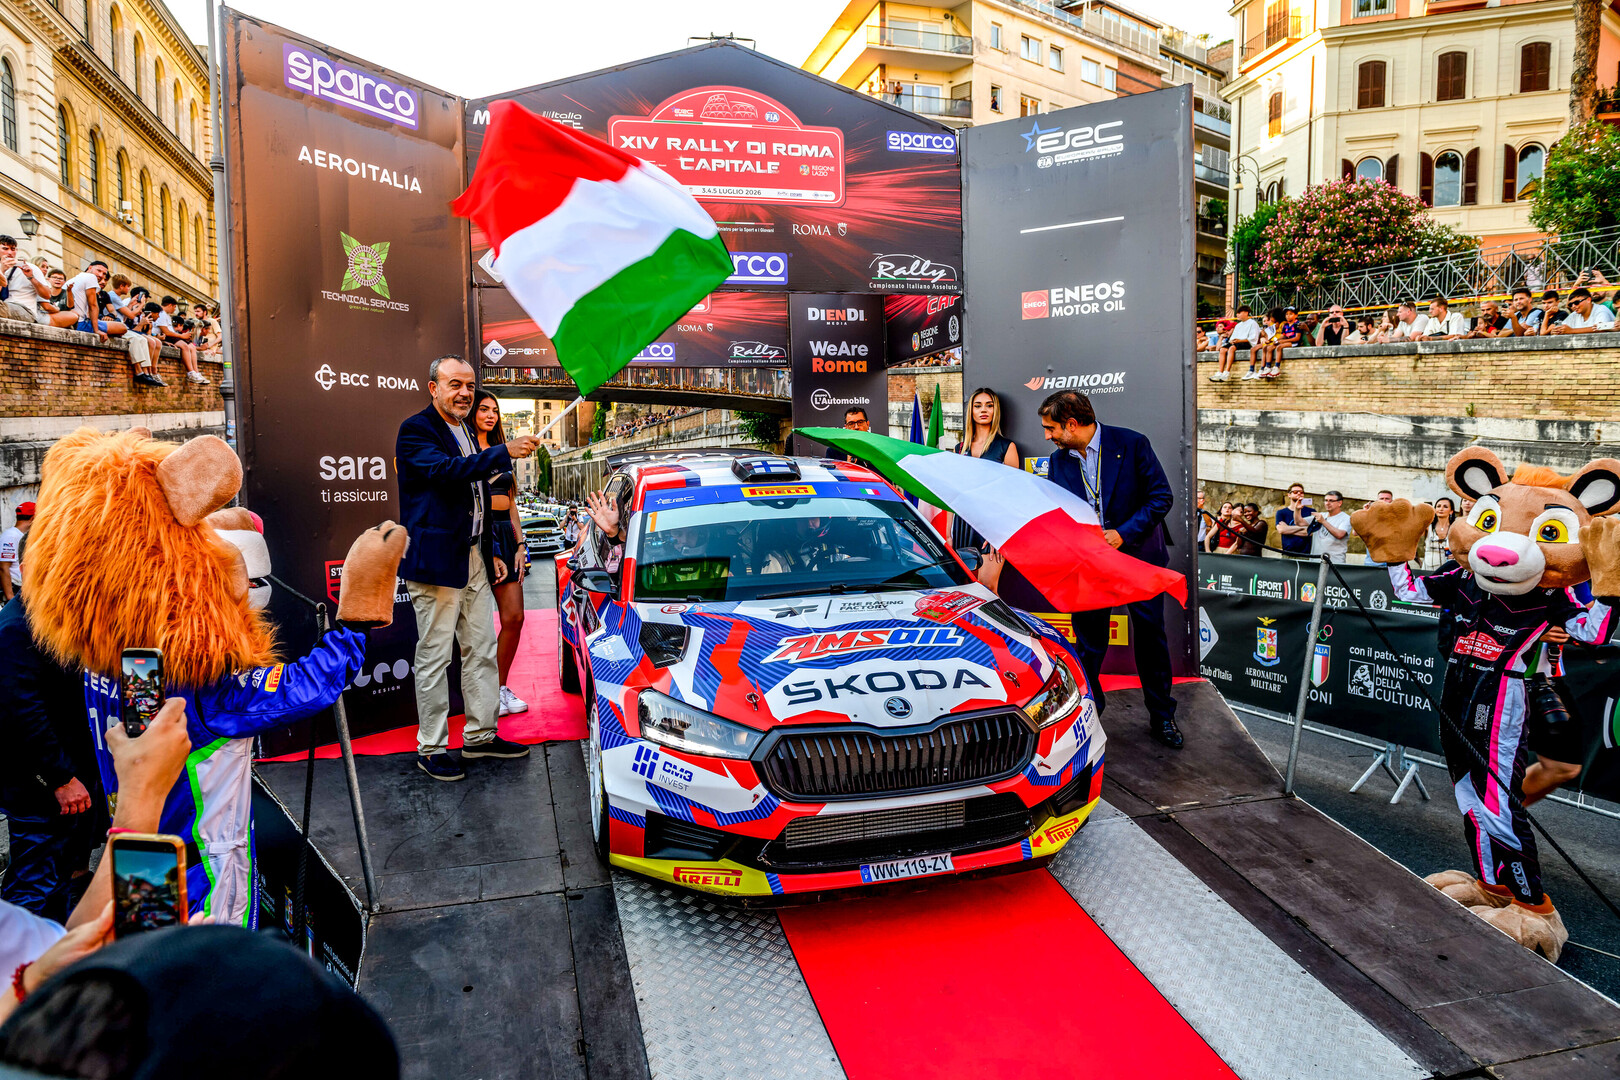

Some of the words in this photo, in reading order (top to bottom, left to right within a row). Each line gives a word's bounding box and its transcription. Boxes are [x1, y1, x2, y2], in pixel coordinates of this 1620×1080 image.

[288, 51, 415, 116] sparco
[888, 132, 954, 151] sparco
[1036, 120, 1124, 154] ERC
[620, 135, 659, 150] XIV
[666, 137, 740, 152] RALLY
[747, 141, 766, 154] DI
[772, 143, 834, 158] ROMA
[680, 158, 780, 174] CAPITALE
[1056, 152, 1122, 166] CHAMPIONSHIP
[298, 145, 422, 194] AEROITALIA
[792, 224, 831, 236] ROMA
[730, 255, 784, 276] rco
[876, 260, 946, 284] Rally
[1050, 280, 1126, 304] ENEOS
[321, 290, 370, 306] TECHNICAL
[370, 298, 410, 312] SERVICES
[1024, 301, 1046, 309] ENEOS
[1052, 303, 1100, 318] MOTOR
[1104, 300, 1126, 312] OIL
[920, 326, 938, 339] REGIONE
[809, 340, 868, 356] WeAre
[921, 337, 934, 348] LAZIO
[733, 345, 780, 359] Rally
[812, 358, 867, 372] Roma
[340, 372, 369, 387] BCC
[378, 376, 419, 391] ROMA
[1091, 386, 1124, 394] emotion
[319, 455, 386, 480] sara
[321, 490, 331, 502] ti
[334, 488, 388, 502] assicura
[749, 487, 808, 495] PIRELLI
[649, 512, 658, 532] 1
[1221, 574, 1232, 583] MIT
[1257, 580, 1283, 591] SPORT
[1262, 590, 1283, 599] SALUTE
[1326, 598, 1348, 607] AZIO
[761, 627, 965, 664] AMSOIL
[1350, 646, 1365, 656] con
[1367, 647, 1372, 657] il
[1424, 657, 1434, 668] di
[1213, 667, 1233, 681] d'Italia
[1245, 667, 1288, 684] AERONAUTICA
[372, 685, 400, 695] DESIGN
[1250, 678, 1281, 693] MILITARE
[1376, 677, 1401, 690] DELLA
[1306, 689, 1332, 704] ONI
[1375, 688, 1432, 711] CULTURA
[662, 761, 693, 782] CM3
[658, 774, 689, 791] INVEST
[872, 855, 949, 879] WW-119-ZY
[673, 866, 742, 886] PIRELLI
